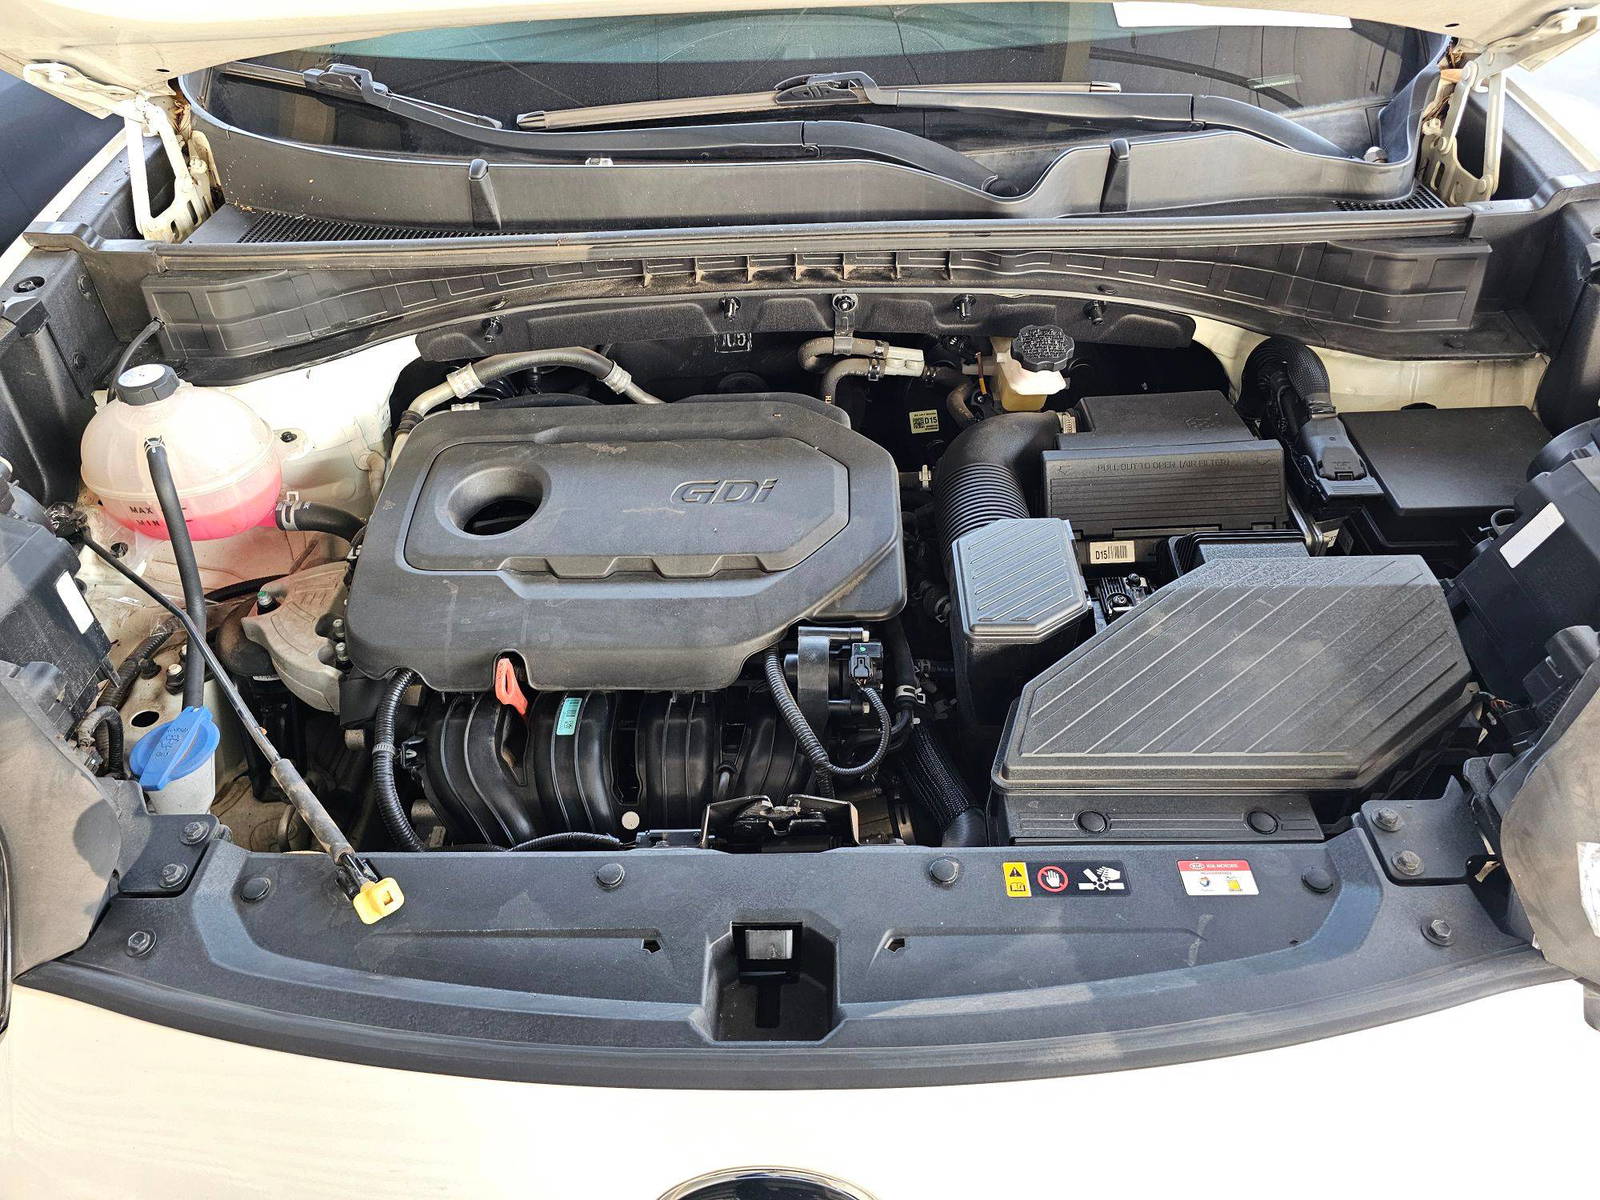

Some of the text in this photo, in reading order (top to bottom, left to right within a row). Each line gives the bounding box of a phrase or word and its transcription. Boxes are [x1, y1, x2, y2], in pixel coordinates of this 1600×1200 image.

[925, 416, 937, 425] D15
[670, 478, 779, 504] GDi
[129, 506, 154, 515] MAX
[136, 519, 161, 527] MIN
[1095, 550, 1108, 560] D15
